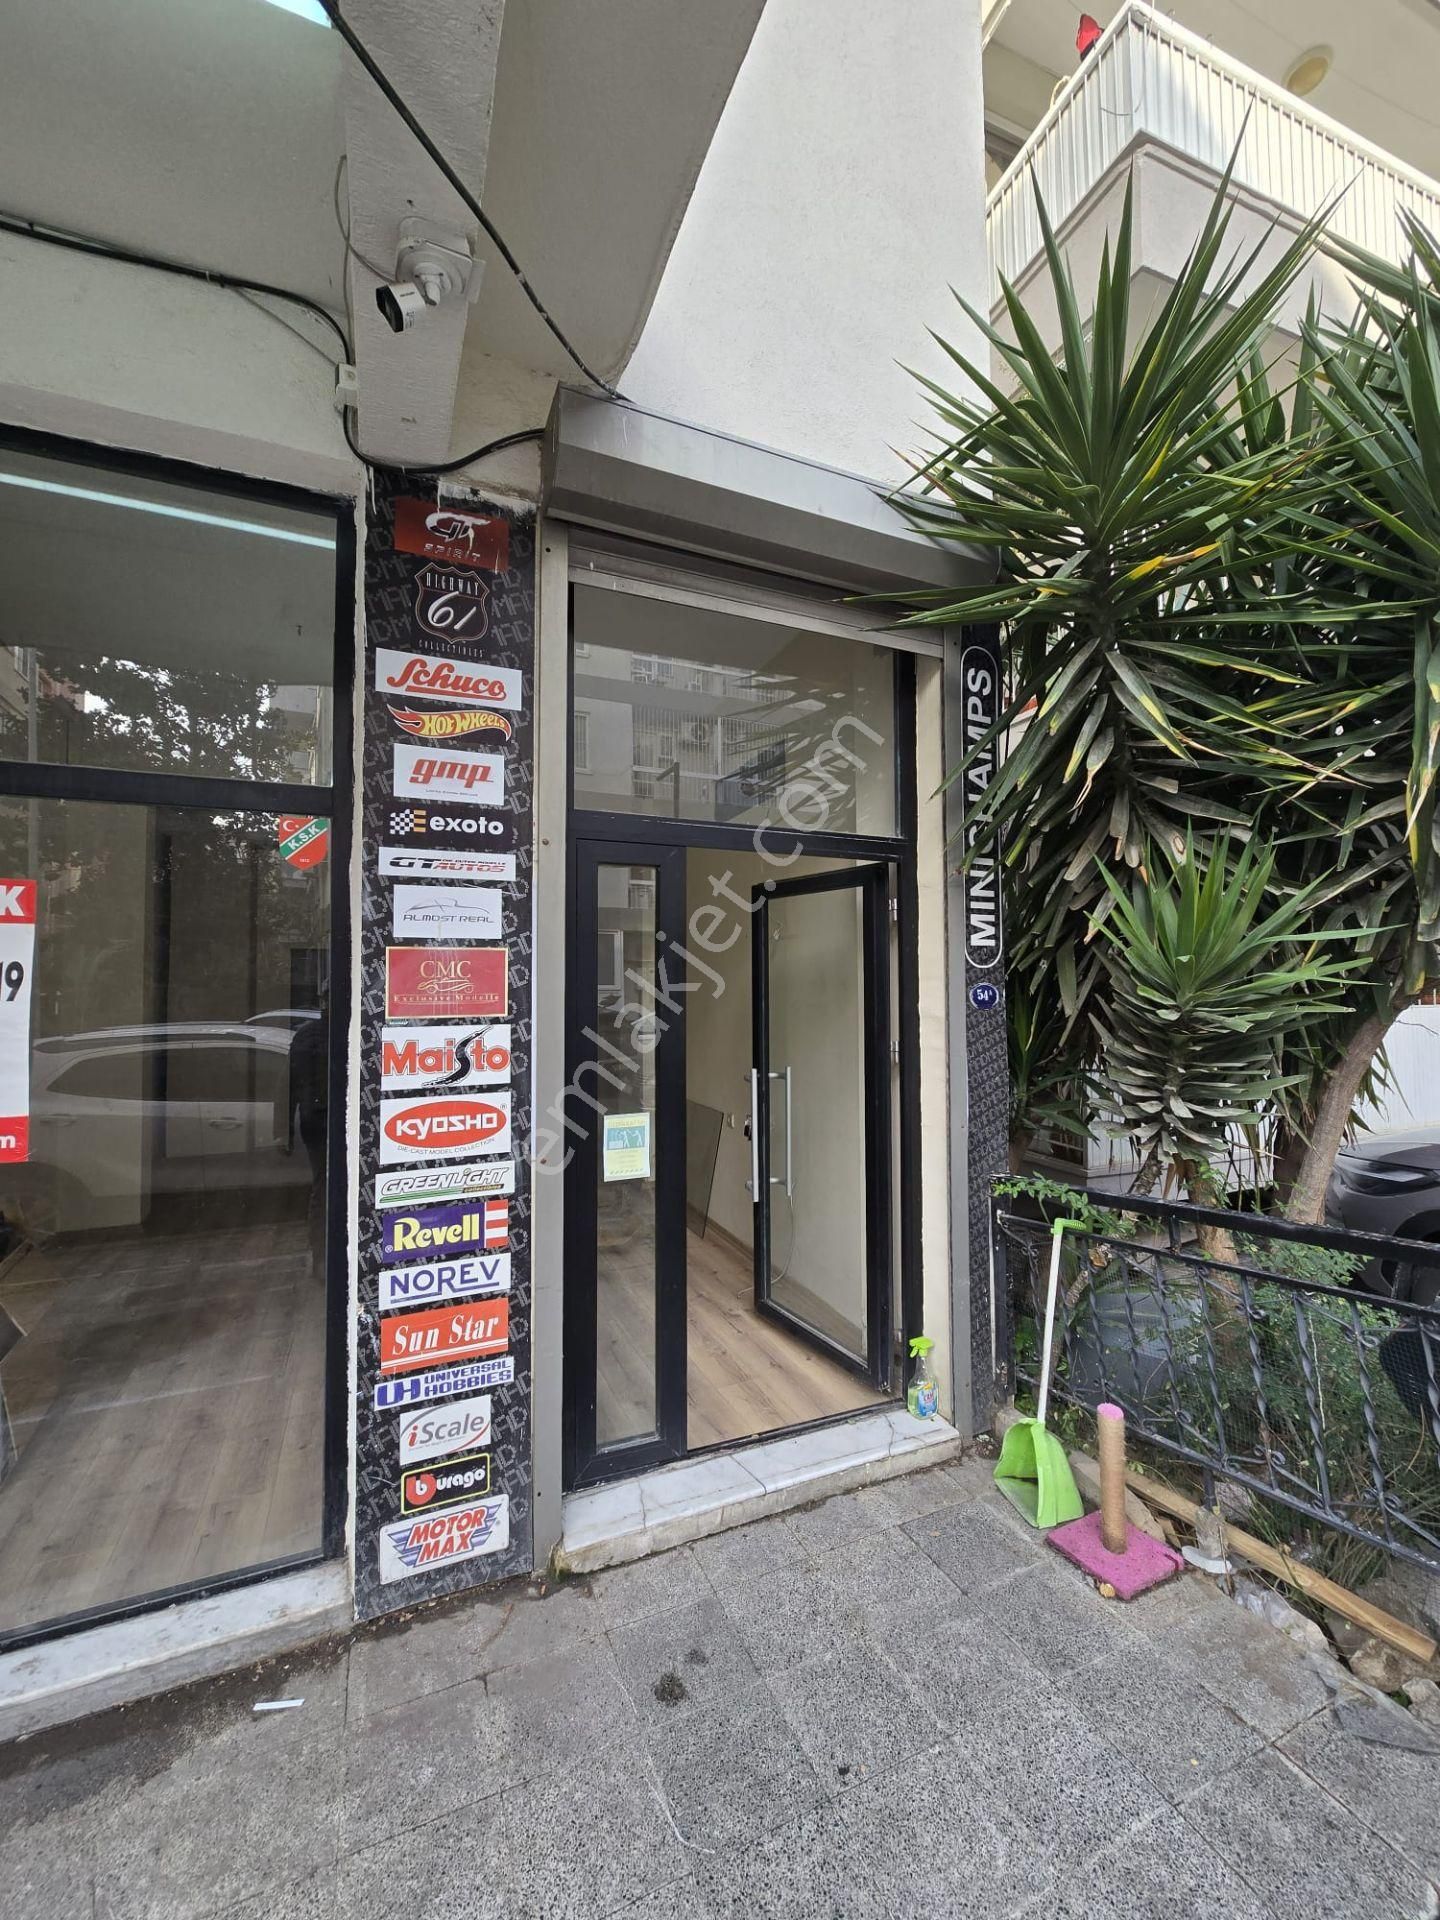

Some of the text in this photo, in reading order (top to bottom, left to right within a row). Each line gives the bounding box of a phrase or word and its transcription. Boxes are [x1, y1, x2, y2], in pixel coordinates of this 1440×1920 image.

[426, 572, 479, 596] HIGHWAY
[427, 590, 477, 630] 61
[386, 658, 507, 699] Schuco
[409, 758, 494, 788] gmp
[288, 824, 320, 850] K.S.K
[430, 816, 504, 835] exoto
[433, 862, 506, 873] AUTOS
[403, 914, 495, 924] ALMOST REAL
[420, 960, 472, 979] CMC
[382, 1026, 511, 1086] Maisto
[396, 1112, 498, 1140] KYOSHO
[394, 1213, 479, 1252] Revell
[391, 1259, 500, 1297] NOREV
[392, 1313, 499, 1355] Sun Star
[424, 1359, 512, 1383] UNIVERSAL
[424, 1369, 512, 1397] HOBBIES
[408, 1412, 485, 1447] iScale
[408, 1506, 487, 1547] MOTOR
[417, 1530, 472, 1564] MAX
